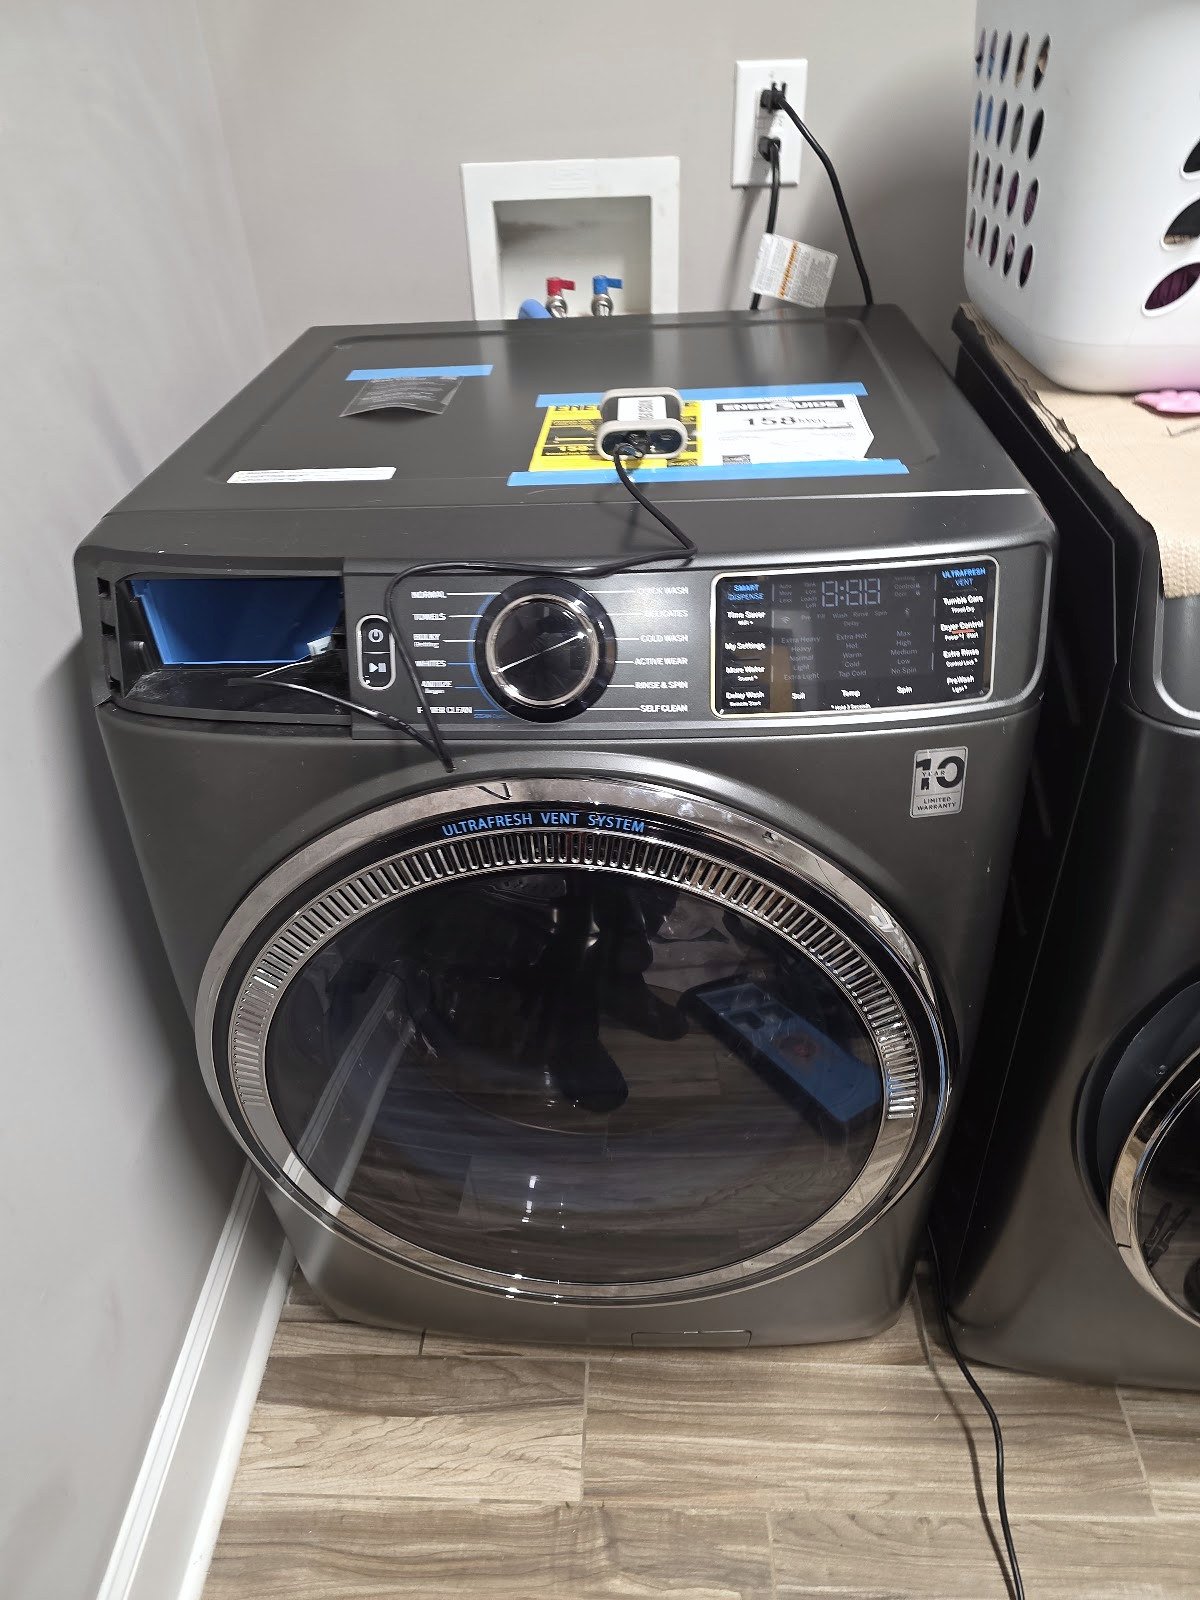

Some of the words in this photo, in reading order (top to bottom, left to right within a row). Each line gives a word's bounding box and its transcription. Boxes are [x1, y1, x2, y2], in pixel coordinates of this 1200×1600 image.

[954, 577, 973, 586] VENT
[664, 586, 689, 594] WASH
[942, 596, 967, 605] Tumble
[967, 595, 983, 603] Care
[959, 619, 984, 630] Control
[640, 634, 663, 642] COLD
[664, 634, 689, 642] WASH
[724, 643, 736, 651] My
[737, 642, 766, 651] Settings
[634, 657, 663, 665] ACTIVE
[664, 657, 688, 665] WEAR
[634, 681, 660, 689] RINSE
[668, 681, 688, 689] SPIN
[841, 689, 861, 698] Temp
[896, 685, 913, 695] Spin
[640, 704, 660, 712] SELF
[660, 704, 688, 712] CLEAN
[915, 755, 965, 791] 10
[923, 796, 952, 804] LIMITED
[916, 801, 957, 811] WARRANTY
[441, 812, 533, 836] ULTRAFRESH
[540, 812, 579, 825] VENT
[587, 813, 645, 833] SYSTEM
